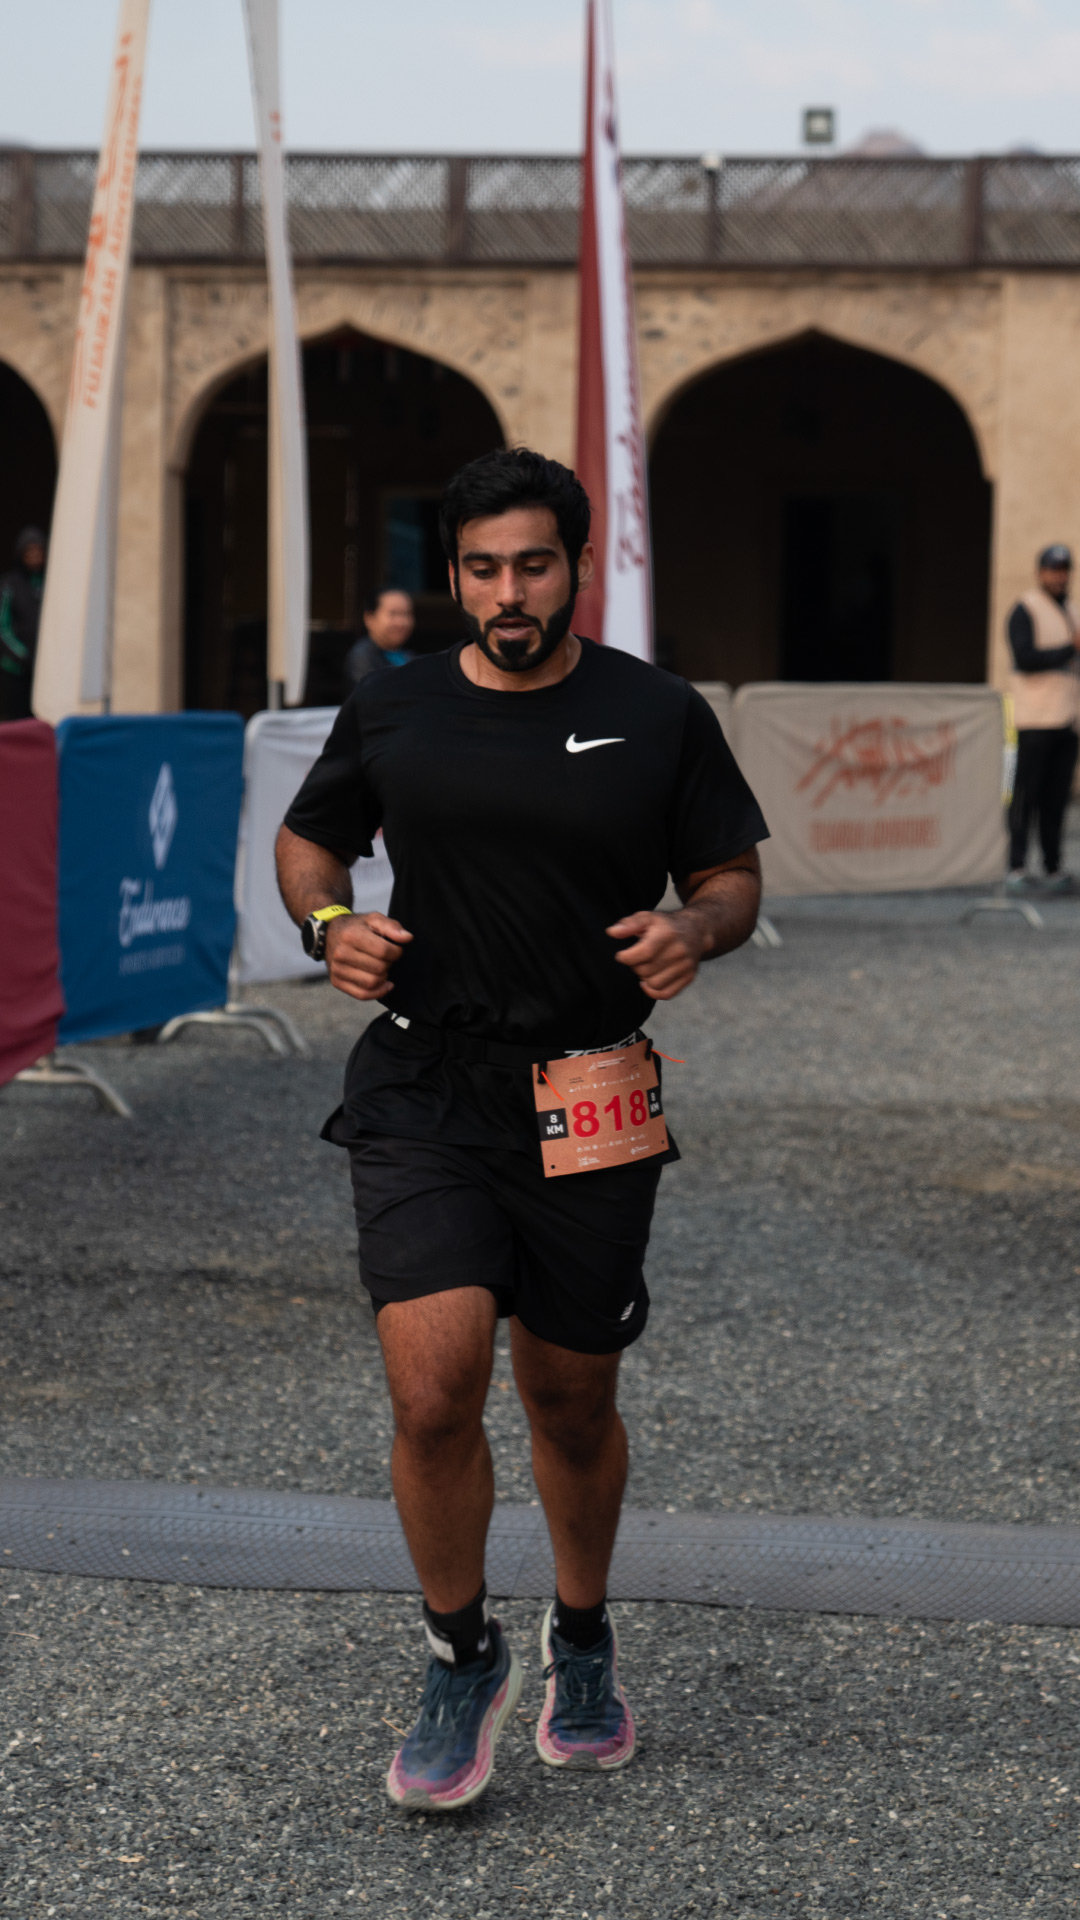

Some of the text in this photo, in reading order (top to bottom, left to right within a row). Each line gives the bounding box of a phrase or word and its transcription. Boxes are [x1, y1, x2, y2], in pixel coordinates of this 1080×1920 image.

[83, 269, 117, 408] FUJAIRAH
[549, 1114, 558, 1124] 8
[572, 1090, 647, 1137] 818
[546, 1124, 564, 1135] KM
